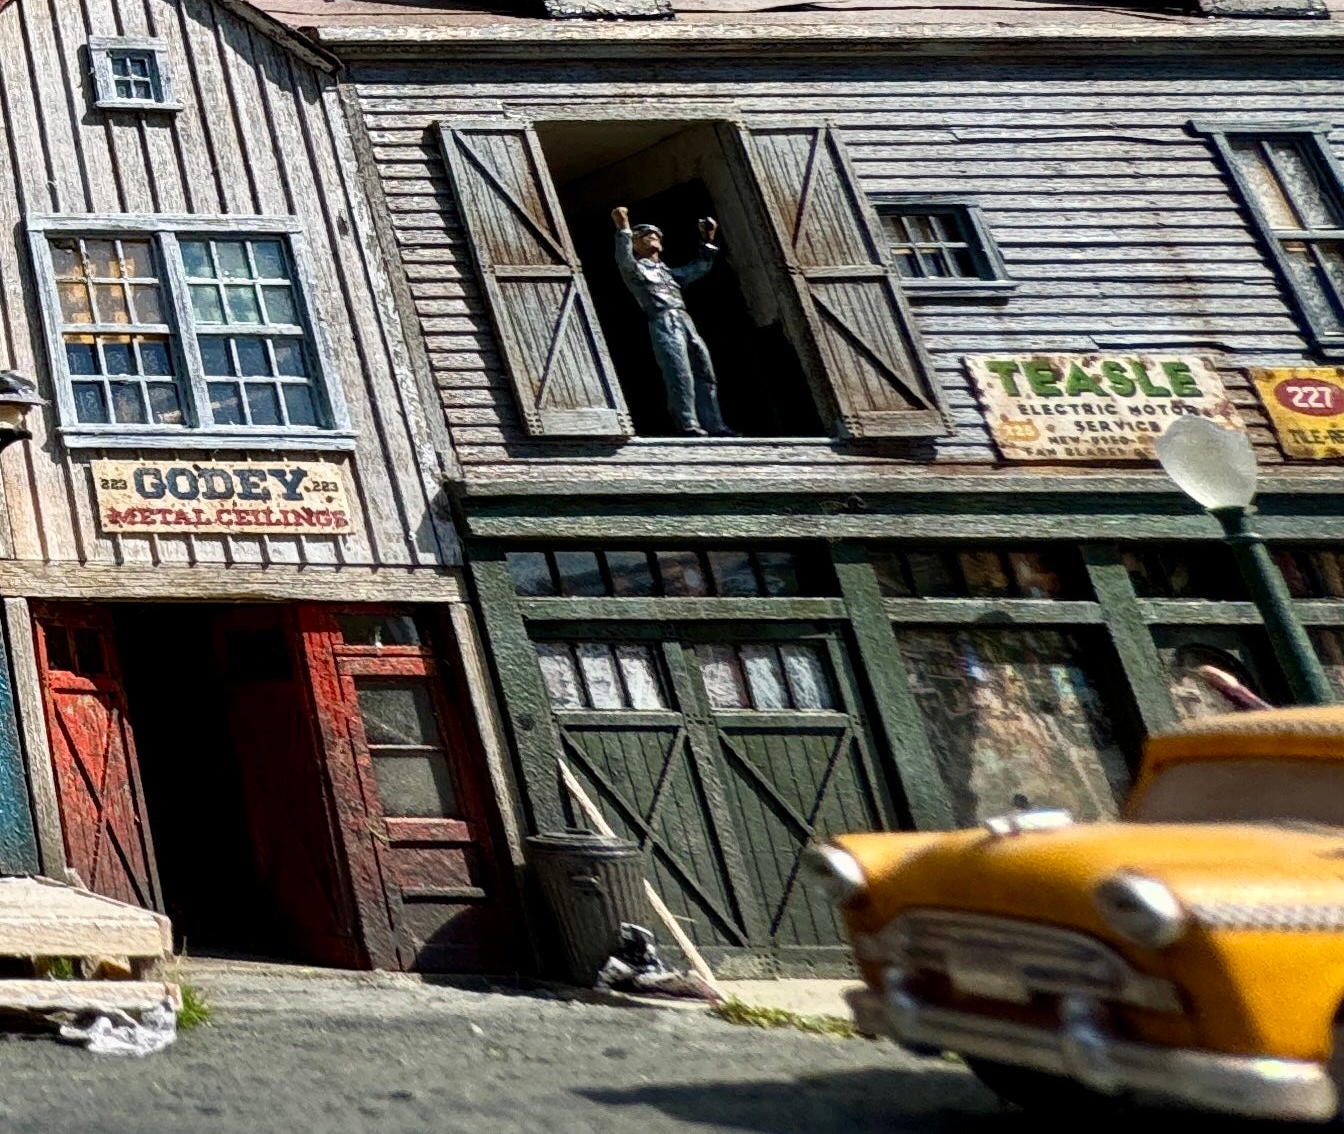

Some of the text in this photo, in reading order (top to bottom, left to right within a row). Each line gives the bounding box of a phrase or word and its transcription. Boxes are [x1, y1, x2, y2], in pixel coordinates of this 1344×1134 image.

[984, 359, 1204, 399] TEASLE
[1286, 386, 1333, 408] 227
[1017, 403, 1119, 416] ELECTRIC
[1073, 420, 1162, 433] SERVICE
[100, 466, 339, 502] 223 GODEY 223
[106, 506, 349, 528] METAL CEILINGS
